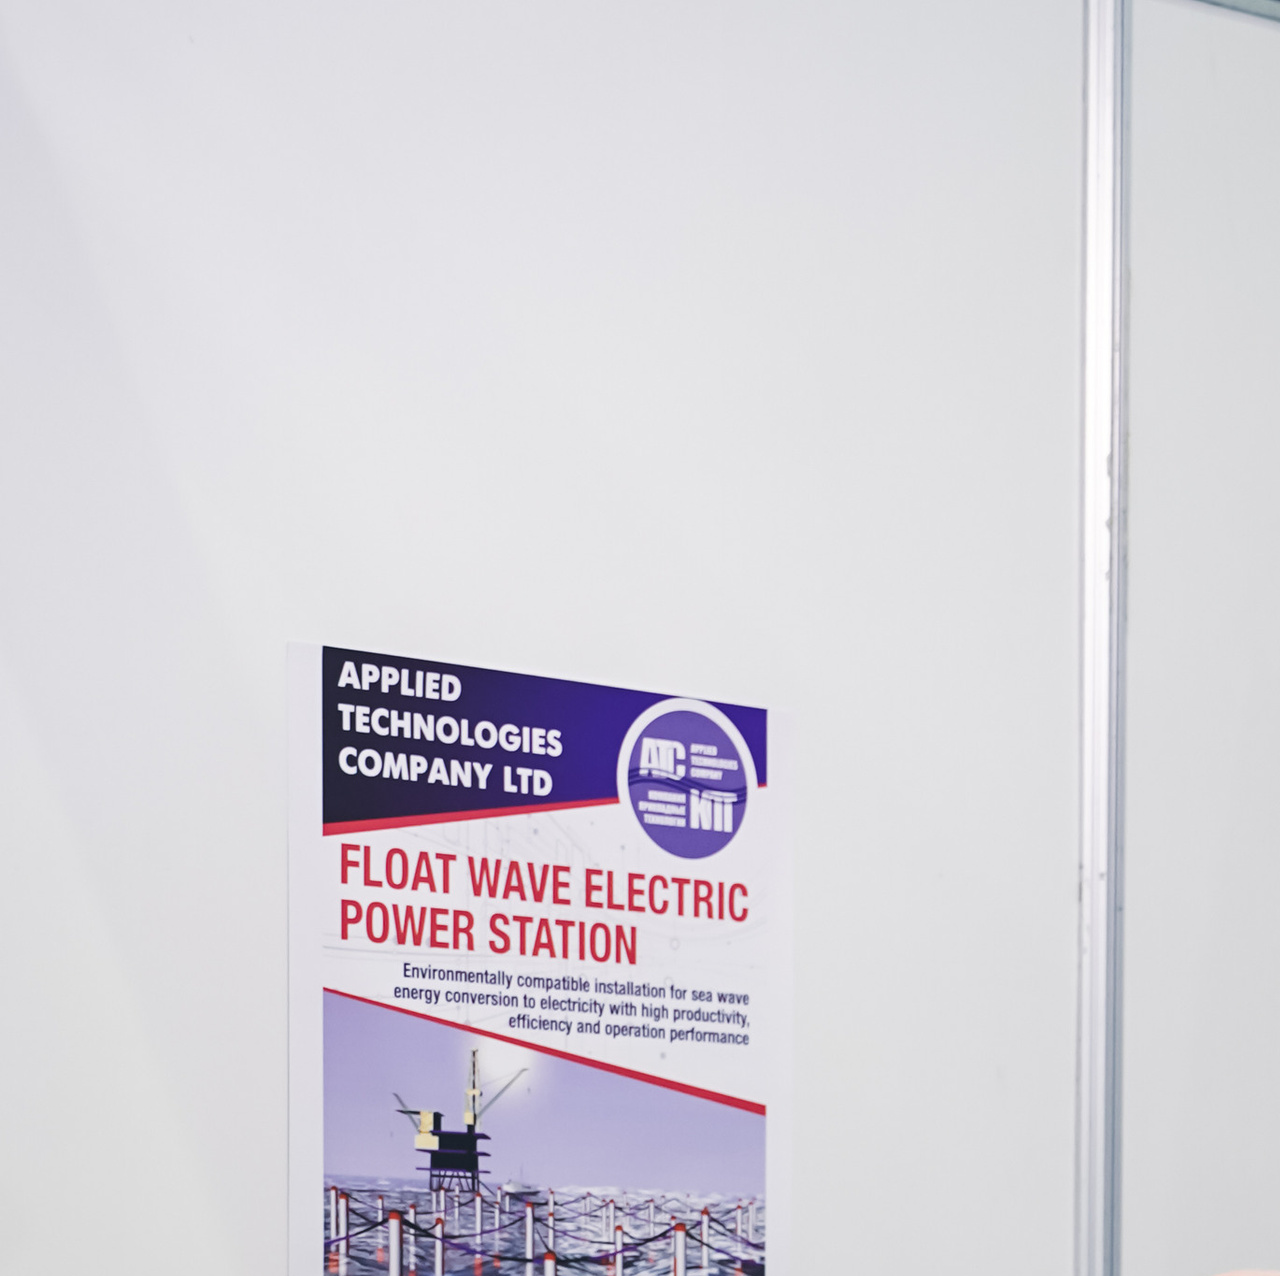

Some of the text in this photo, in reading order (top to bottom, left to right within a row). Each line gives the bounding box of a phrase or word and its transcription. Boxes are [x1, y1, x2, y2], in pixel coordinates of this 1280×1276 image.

[338, 661, 462, 701] APPLIED
[337, 703, 563, 757] TECHNOLOGIES
[338, 747, 553, 797] COMPANY LTD
[340, 843, 749, 923] FLOAT WAVE ELECTRIC
[341, 899, 638, 965] POWER STATION
[393, 986, 750, 1029] energy conversion to electricity with high productivity,
[403, 962, 750, 1006] Environmentally compatible installation for sea wave
[508, 1014, 750, 1046] efficiency and operation performance
